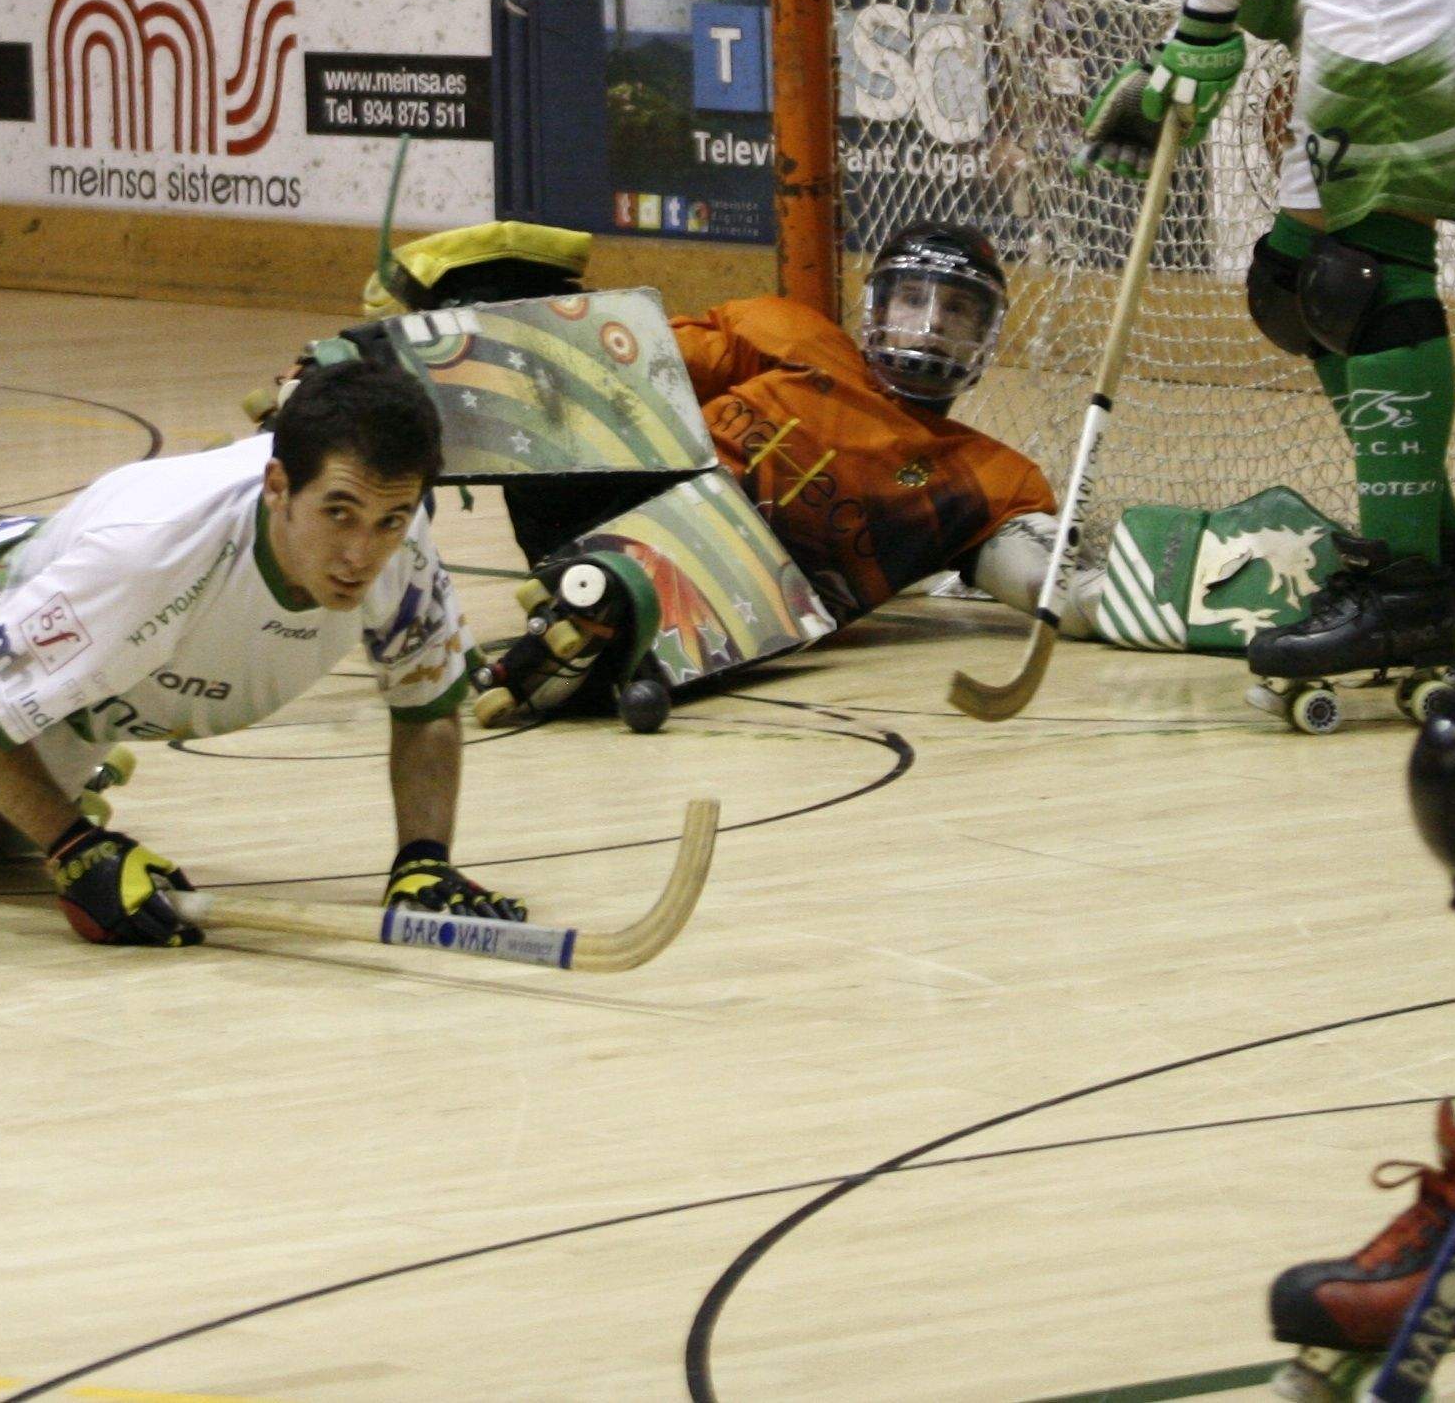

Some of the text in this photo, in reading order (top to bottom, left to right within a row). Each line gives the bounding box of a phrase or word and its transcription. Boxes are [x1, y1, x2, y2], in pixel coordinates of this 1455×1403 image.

[324, 66, 467, 97] www.meinsa.es
[325, 98, 466, 129] Tel. 934 875 511
[905, 141, 993, 186] Cugat
[1306, 126, 1352, 183] 82
[50, 162, 303, 209] meinsa sistemas
